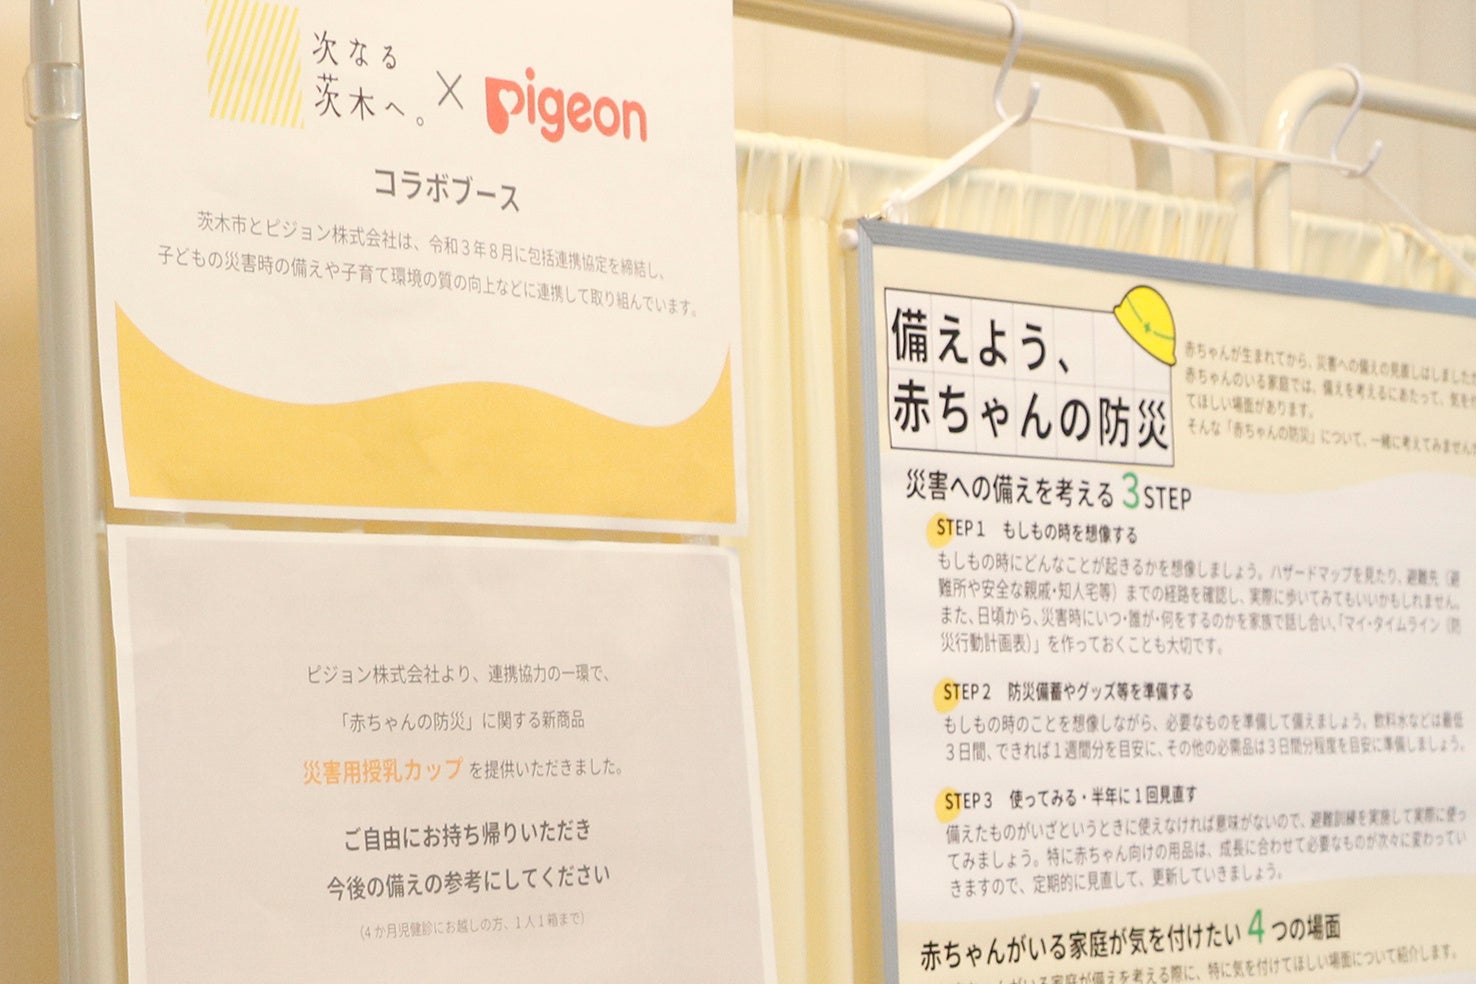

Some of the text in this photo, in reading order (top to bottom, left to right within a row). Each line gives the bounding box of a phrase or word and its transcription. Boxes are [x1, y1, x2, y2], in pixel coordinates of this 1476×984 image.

[375, 168, 519, 212] コラボブース
[892, 307, 1069, 374] 備えよう、
[894, 379, 1169, 450] 赤ちゃんの防災
[1004, 520, 1137, 544] もしもの時を想像する
[303, 757, 464, 785] 災害用授乳カップ
[344, 818, 591, 851] ご自由にお持ち帰りいただき
[327, 864, 610, 901] 今後の備えの参考にしてください
